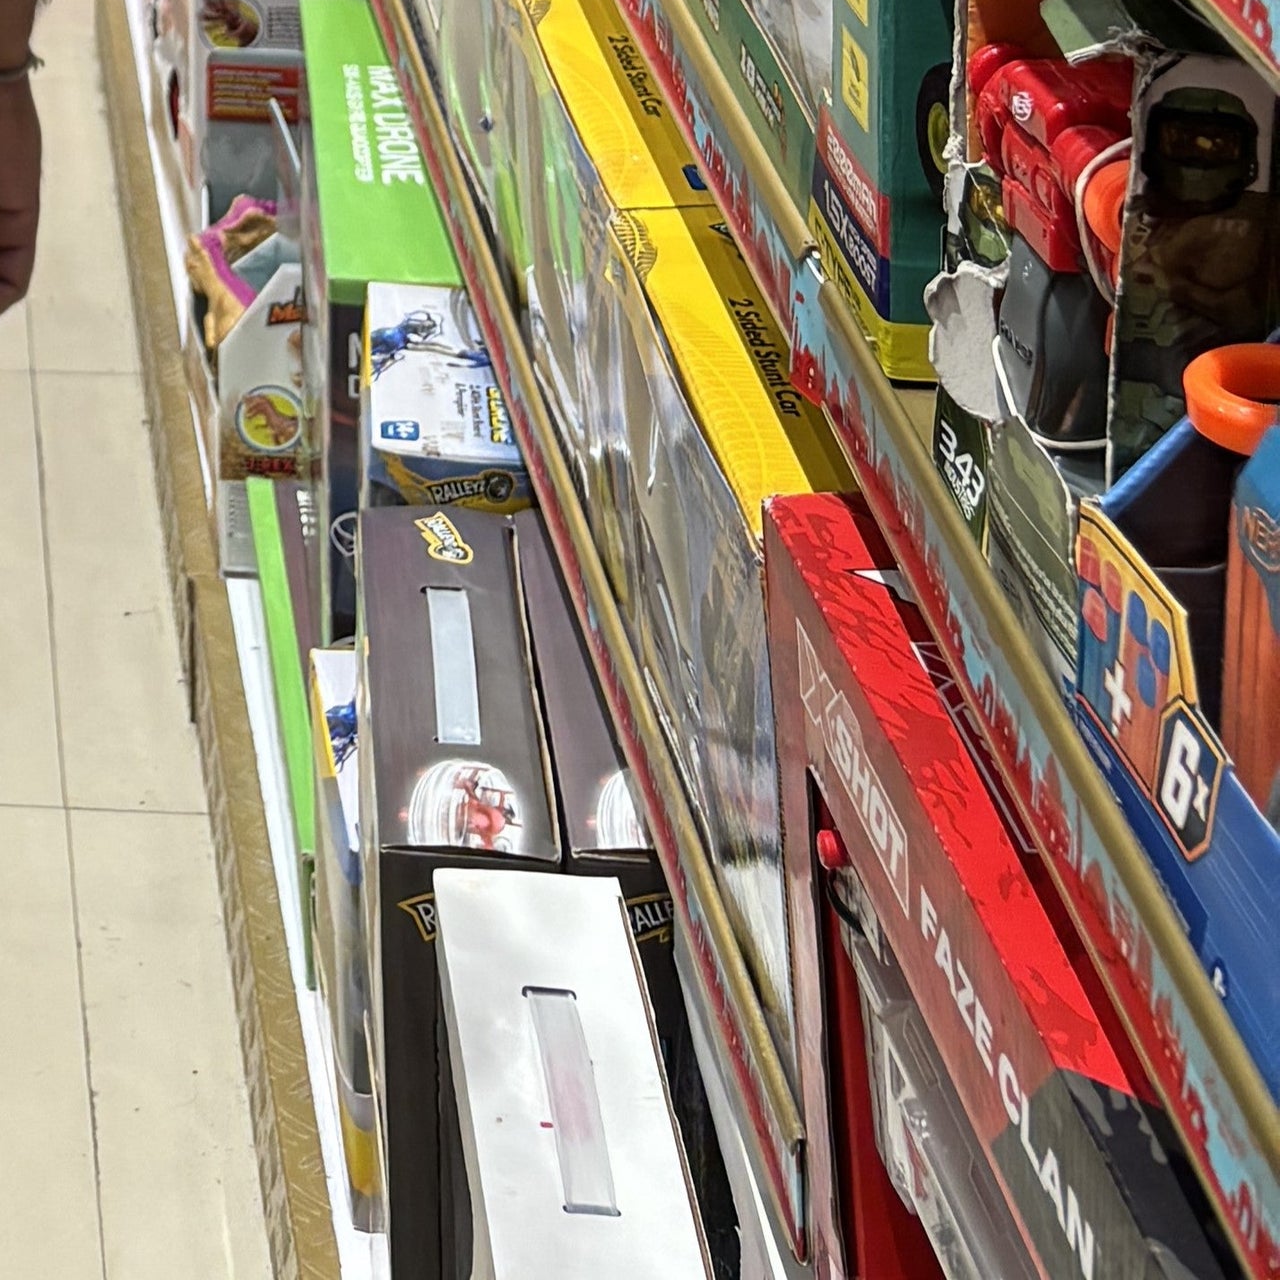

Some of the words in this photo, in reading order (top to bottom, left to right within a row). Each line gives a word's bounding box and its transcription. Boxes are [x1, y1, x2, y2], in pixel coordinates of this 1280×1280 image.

[367, 65, 398, 110] MAX
[374, 111, 424, 186] DRONE
[734, 310, 776, 348] Sided
[754, 349, 791, 387] Stunt
[774, 389, 803, 418] Car
[940, 420, 987, 492] 343
[919, 885, 994, 1077] FAZE
[997, 1054, 1097, 1280] CLAN
